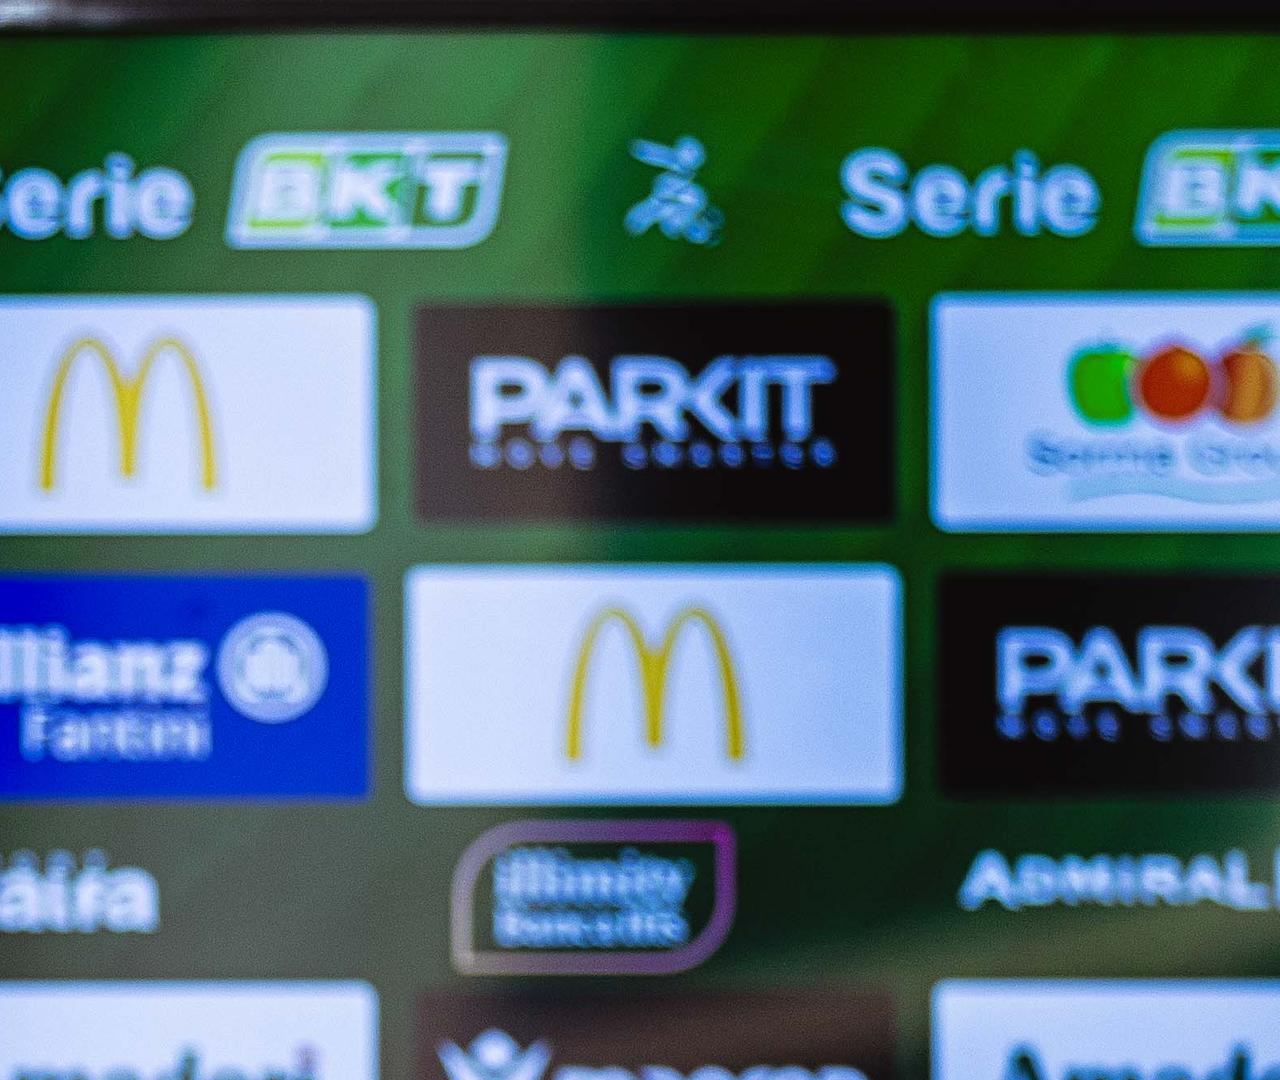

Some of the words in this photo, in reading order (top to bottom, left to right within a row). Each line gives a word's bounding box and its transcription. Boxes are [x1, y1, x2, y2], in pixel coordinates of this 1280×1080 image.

[256, 158, 484, 228] BKT
[841, 148, 1100, 237] Serie
[469, 356, 832, 442] PARKIT
[961, 851, 1274, 911] ADMIRAL
